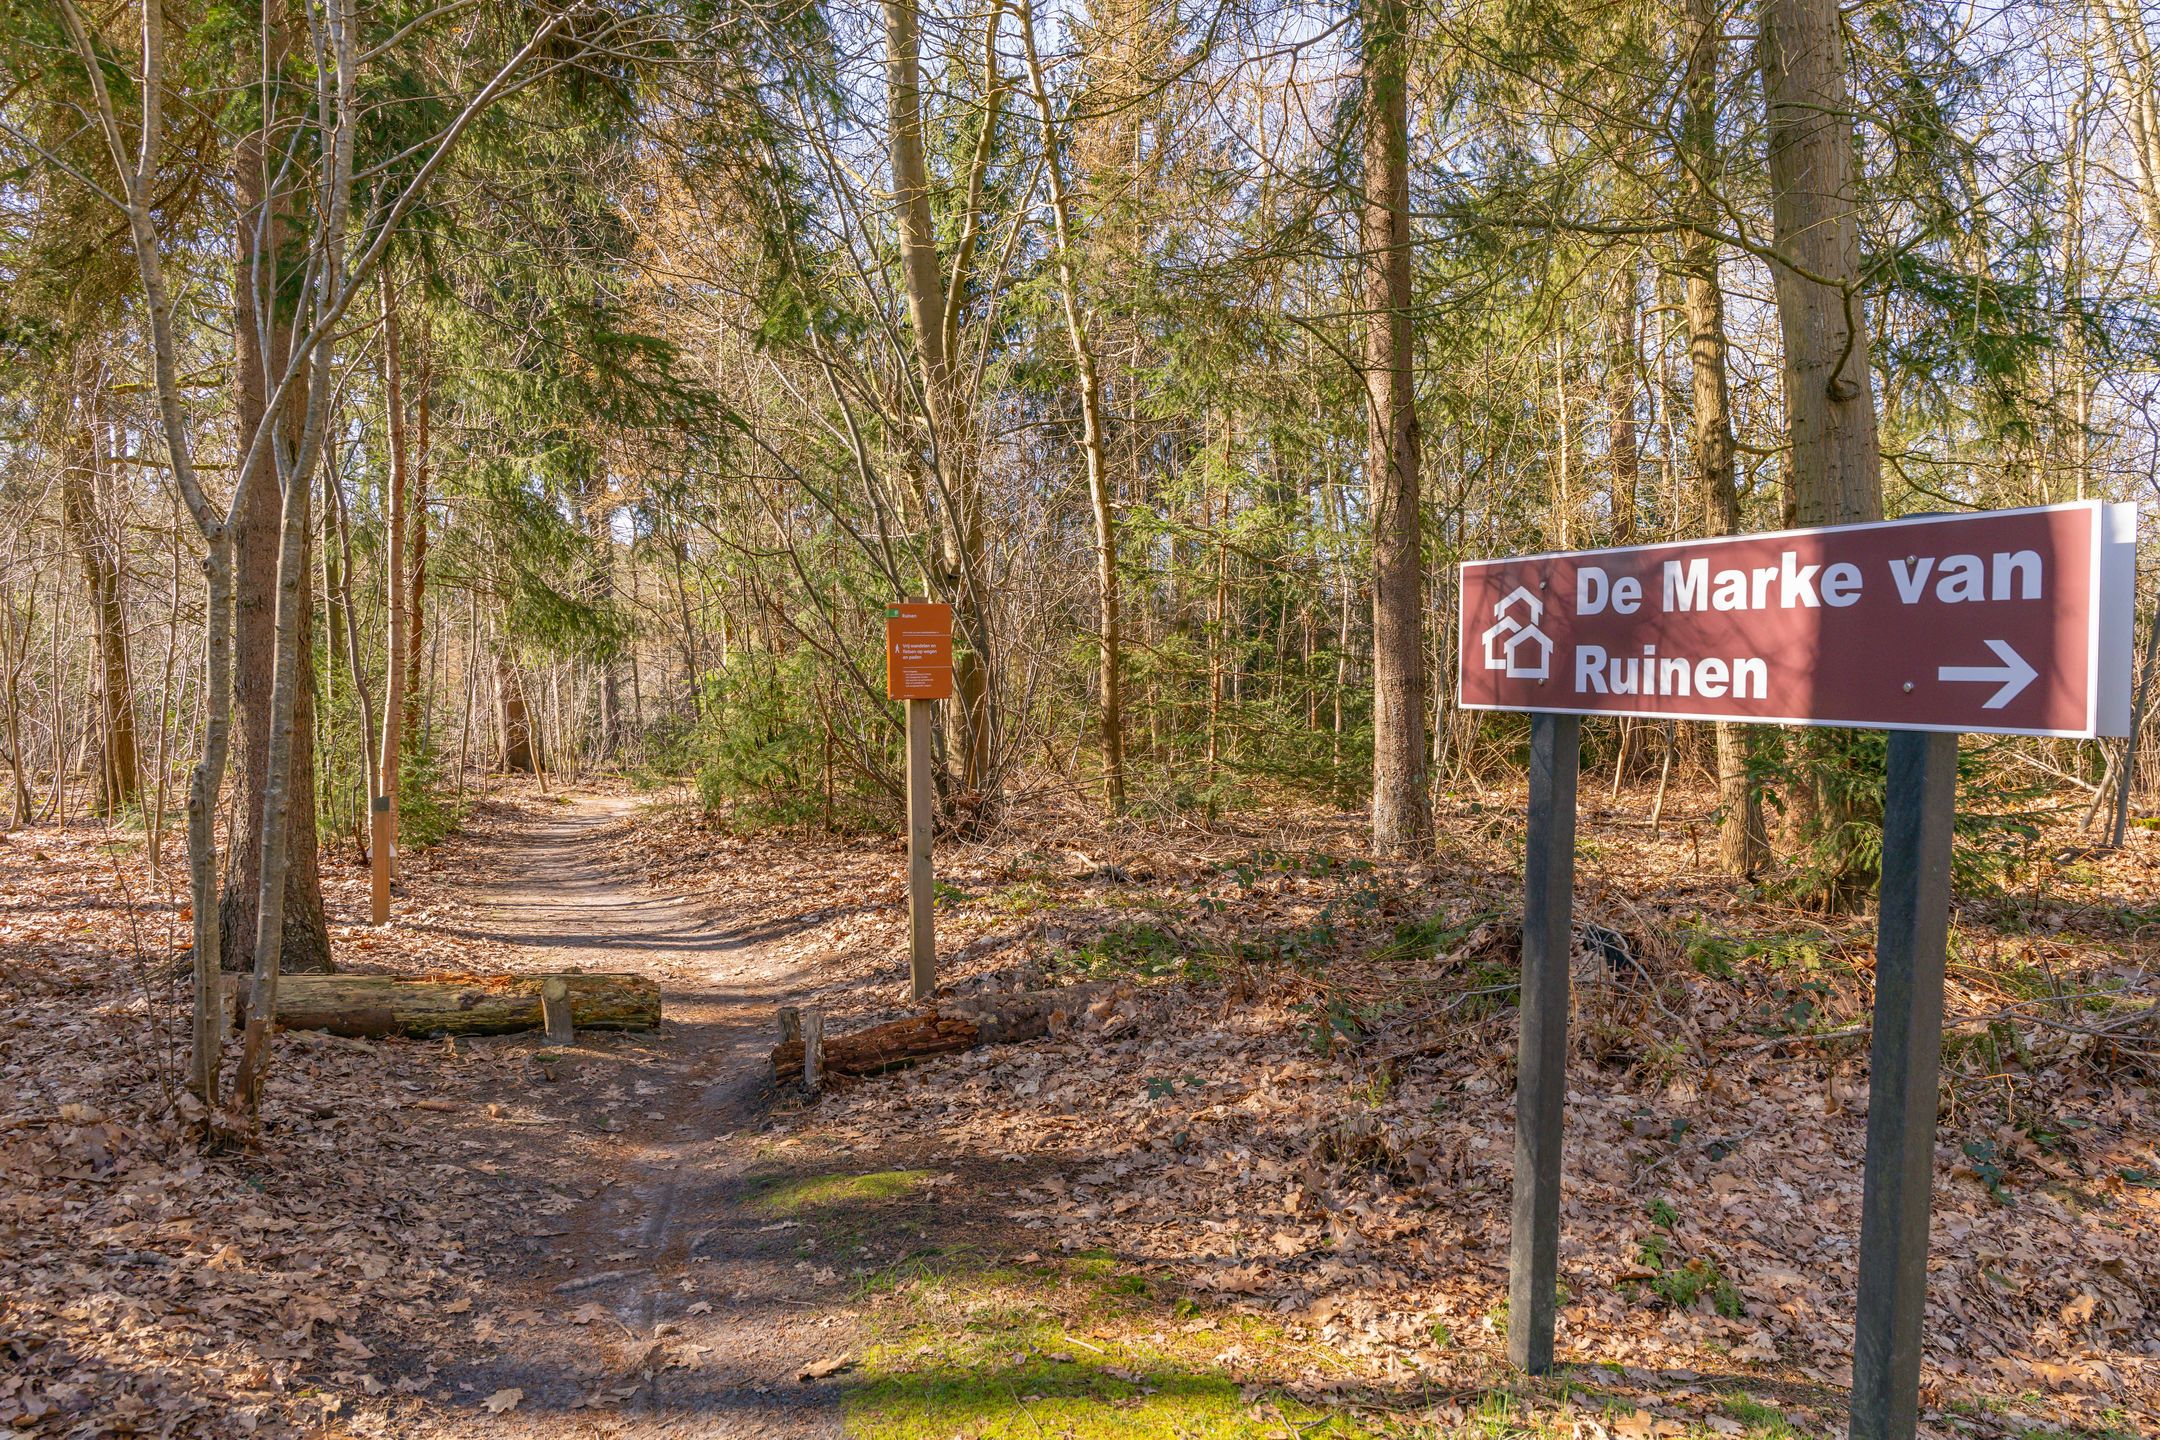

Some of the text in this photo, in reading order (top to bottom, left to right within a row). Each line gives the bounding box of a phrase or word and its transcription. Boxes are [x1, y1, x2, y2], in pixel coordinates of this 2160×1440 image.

[1576, 550, 2042, 615] De Marke van
[1575, 645, 1768, 700] Ruinen
